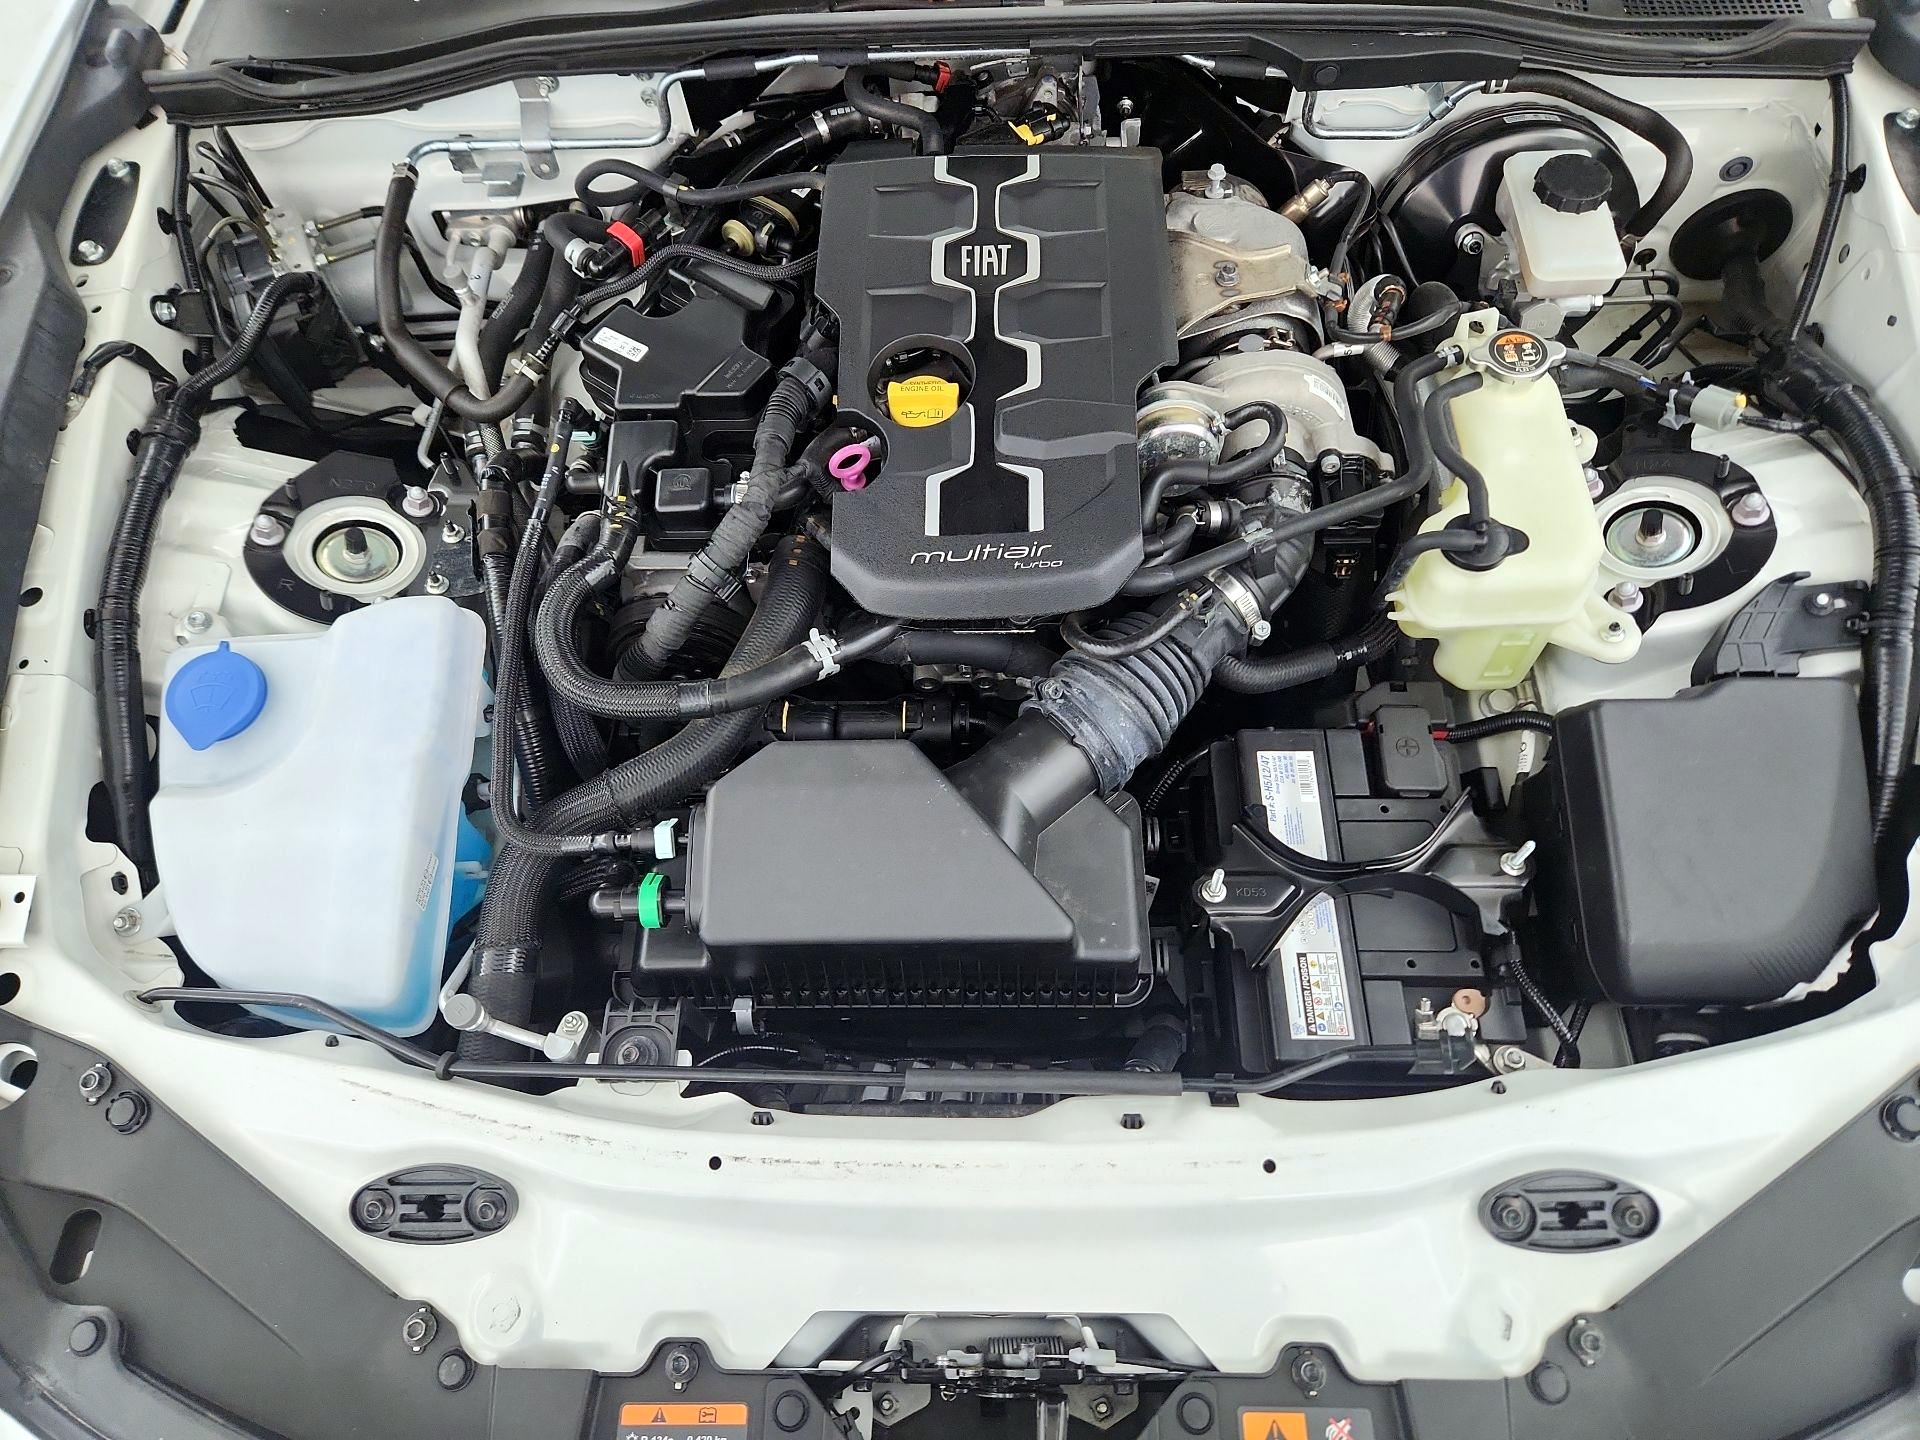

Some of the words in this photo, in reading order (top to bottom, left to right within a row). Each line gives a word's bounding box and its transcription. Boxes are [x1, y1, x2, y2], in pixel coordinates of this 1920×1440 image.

[961, 244, 1012, 277] FIAT
[910, 541, 1053, 565] multiair
[1013, 560, 1064, 570] turbo
[1304, 992, 1315, 1024] DANGER
